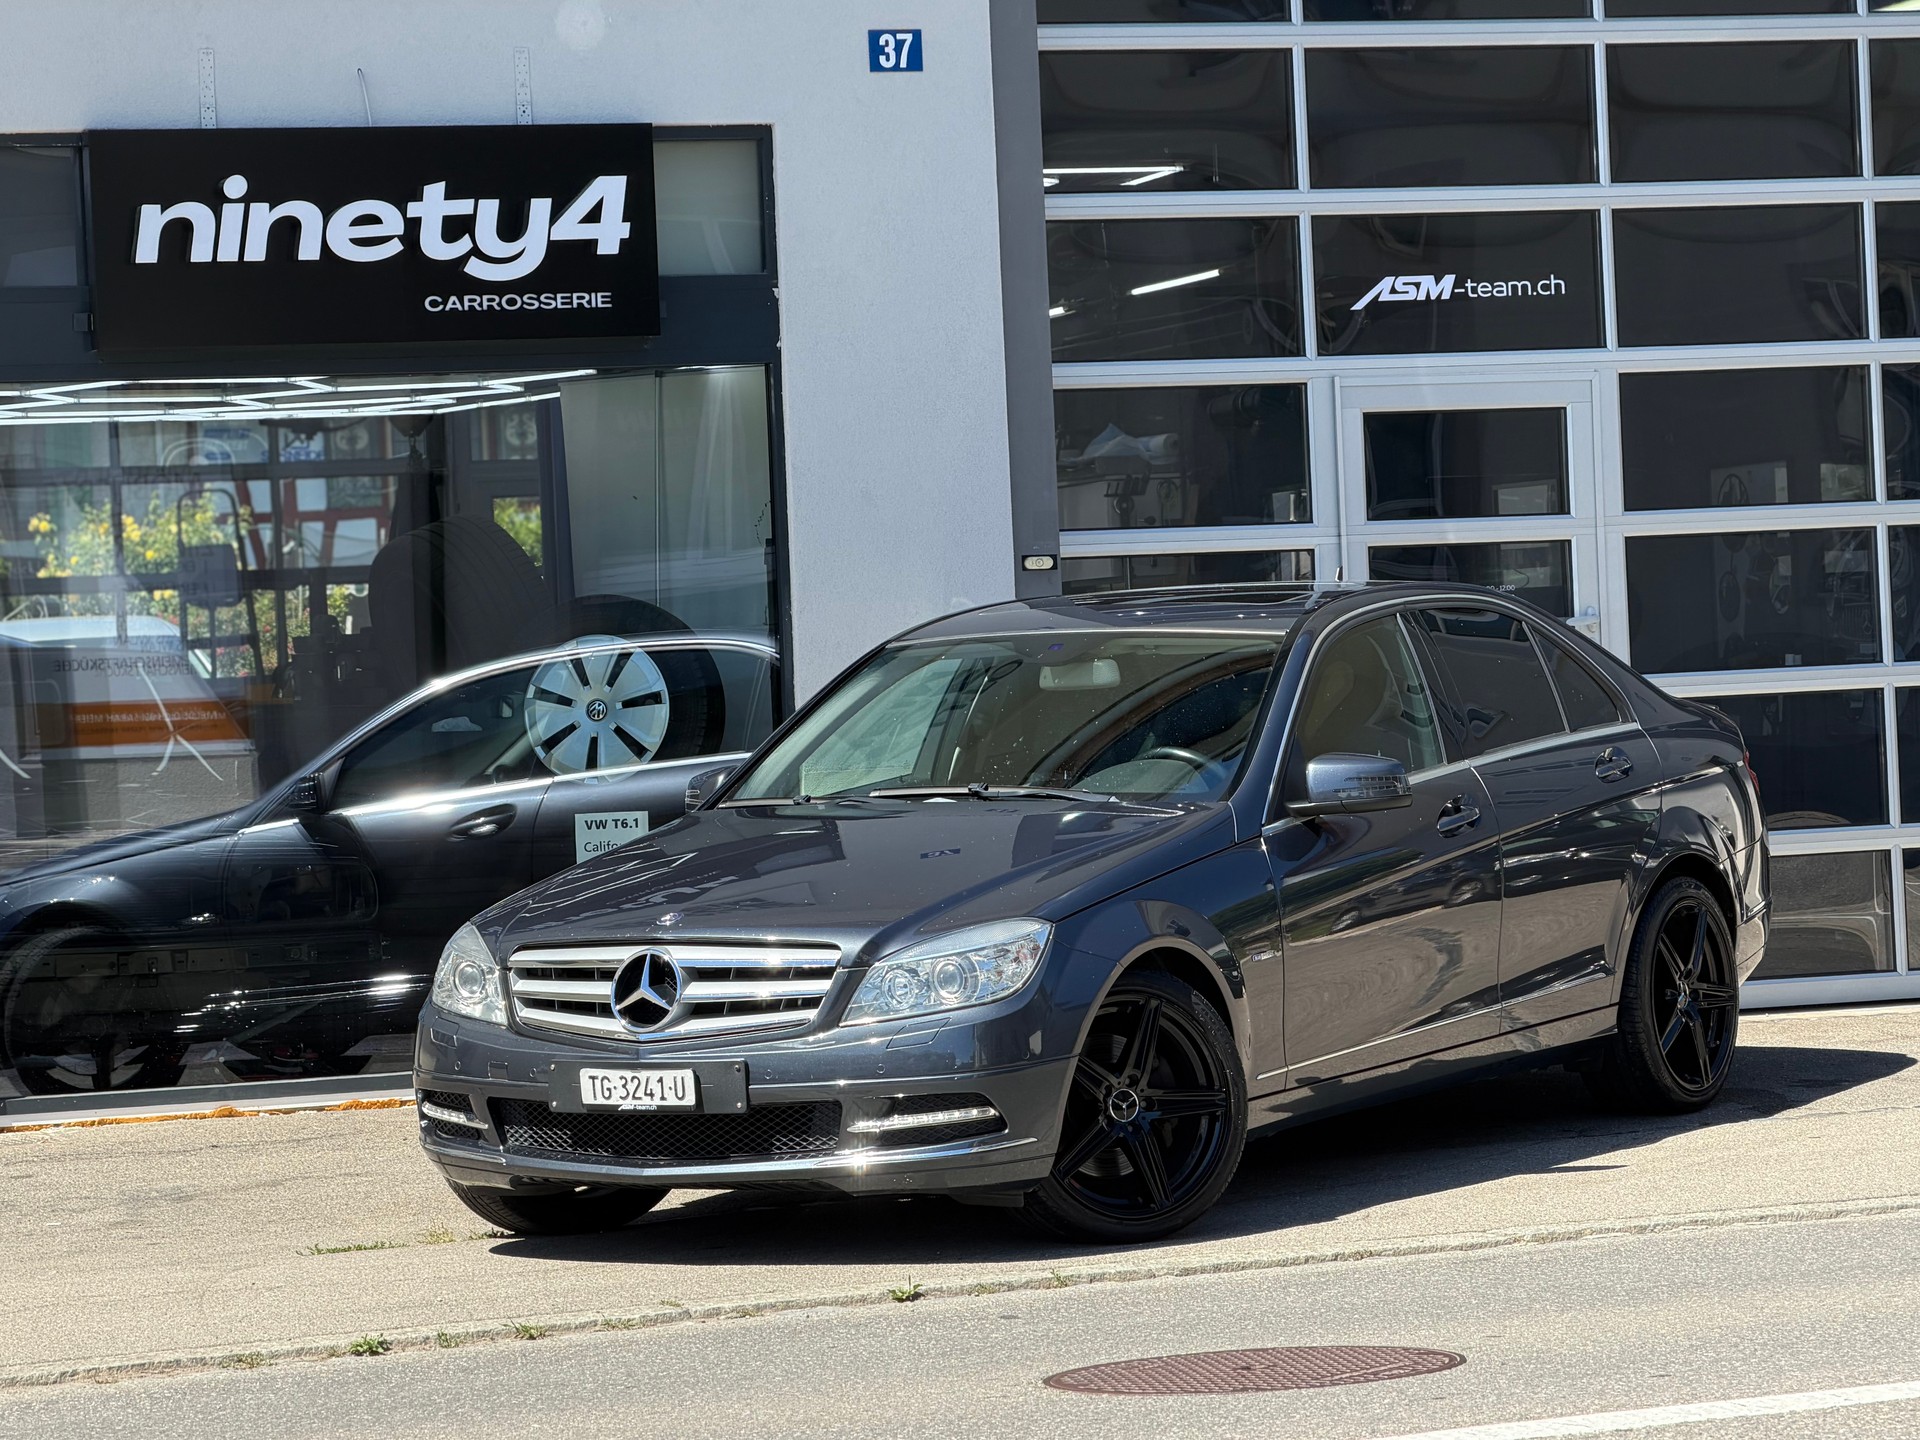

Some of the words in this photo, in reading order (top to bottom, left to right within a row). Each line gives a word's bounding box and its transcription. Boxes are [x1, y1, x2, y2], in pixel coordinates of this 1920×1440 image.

[879, 33, 913, 68] 37
[132, 174, 631, 282] ninety4
[424, 292, 613, 312] CARROSSERIE
[1350, 274, 1566, 311] ASM-team.ch
[584, 819, 608, 830] VW
[612, 817, 639, 829] T6.1
[584, 840, 622, 853] Califo
